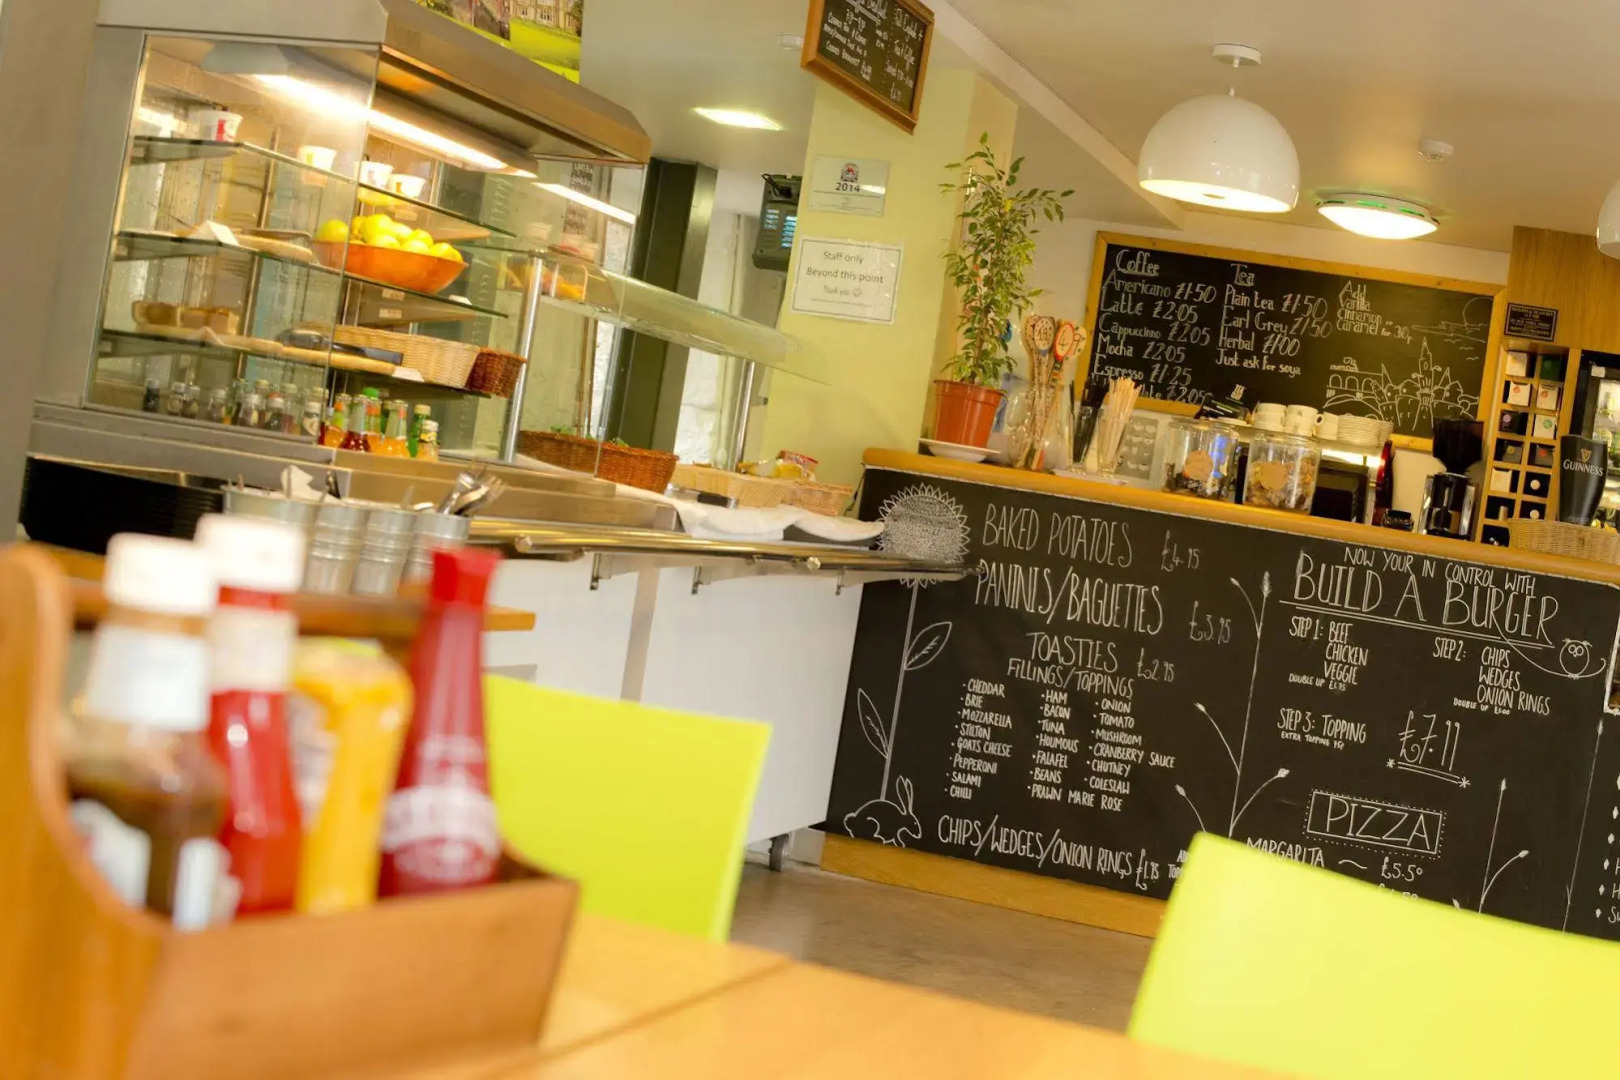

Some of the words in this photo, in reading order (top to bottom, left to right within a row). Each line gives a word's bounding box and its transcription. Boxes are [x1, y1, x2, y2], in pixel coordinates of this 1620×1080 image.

[835, 182, 860, 192] 2014
[823, 251, 843, 261] Staff
[844, 254, 864, 265] only
[1115, 249, 1160, 275] Coffee
[806, 266, 838, 279] Beyond
[840, 270, 857, 281] this
[859, 273, 884, 284] point
[1102, 269, 1171, 298] Americano
[1230, 263, 1255, 285] Tea
[1224, 284, 1250, 307] Plain
[1254, 290, 1275, 311] tea
[1339, 280, 1367, 299] Add
[1100, 288, 1144, 316] Latte
[1152, 300, 1198, 324] £2.05
[1339, 295, 1371, 312] Vanilla
[1221, 305, 1250, 329] Earl
[1254, 311, 1288, 337] Grey
[1096, 333, 1134, 357] Mocha
[1219, 325, 1255, 352] Herbal
[1093, 352, 1144, 381] Espresso
[1149, 363, 1192, 387] £1.25
[1215, 347, 1240, 367] Just
[1242, 355, 1260, 369] ask
[1261, 355, 1277, 371] for
[1278, 364, 1301, 378] soya
[1562, 459, 1604, 477] GUINNESS
[982, 503, 1039, 551] BAKED
[1048, 512, 1132, 568] POTATOES
[1343, 546, 1375, 567] NOW
[1382, 550, 1414, 574] YOUR
[1421, 559, 1436, 578] IN
[1444, 562, 1496, 588] CONTROL
[1504, 572, 1536, 596] WITH
[1294, 550, 1383, 612] BUILD
[1394, 574, 1427, 622] A
[1442, 580, 1559, 645] BURGER
[1288, 615, 1313, 638] STEP
[1328, 620, 1354, 644] BEEF
[1026, 631, 1118, 673] TOASTIES
[1325, 642, 1369, 666] CHICKEN
[1481, 645, 1511, 669] CHIPS
[1288, 673, 1314, 685] DOUBLE
[1315, 678, 1326, 687] UP
[1323, 660, 1358, 685] VEGGIE
[1478, 665, 1521, 692] WEDGES
[967, 678, 1005, 698] CHEDDAR
[1045, 689, 1068, 704] HAM
[964, 693, 984, 708] BRIE
[1100, 698, 1132, 714] ONION
[1453, 697, 1478, 709] DOUBLE
[1480, 703, 1489, 712] UP
[1476, 684, 1514, 709] ONION
[1517, 690, 1551, 716] RINGS
[961, 708, 1013, 729] MOZZARELLA
[1043, 704, 1071, 720] BACON
[1099, 712, 1135, 729] TOMATO
[959, 724, 991, 741] STILTON
[1041, 719, 1065, 735] TUNA
[1277, 707, 1302, 731] STEP
[1321, 714, 1367, 744] TOPPING
[956, 737, 982, 754] GOATS
[983, 741, 1013, 758] CHEESE
[1039, 733, 1080, 753] HOUMOUS
[1095, 728, 1142, 746] MUSHROOM
[1280, 730, 1302, 742] EXTRA
[1304, 734, 1330, 747] TOPPING
[953, 753, 998, 775] PEPPERONI
[1036, 750, 1069, 769] FALAFEL
[1093, 743, 1144, 764] CRANBERRY
[1149, 752, 1176, 768] SAUCE
[1033, 766, 1062, 784] BEANS
[1091, 759, 1132, 778] CHUTNEY
[951, 771, 982, 788] SALAMI
[1089, 775, 1131, 795] COLESLAW
[949, 784, 972, 800] CHILLI
[1031, 784, 1062, 801] PRAWN
[1067, 789, 1095, 808] MARIE
[1100, 794, 1124, 812] ROSE
[1326, 796, 1430, 850] PIZZA
[1246, 836, 1325, 868] MARGARITA
[1096, 847, 1133, 879] RINGS
